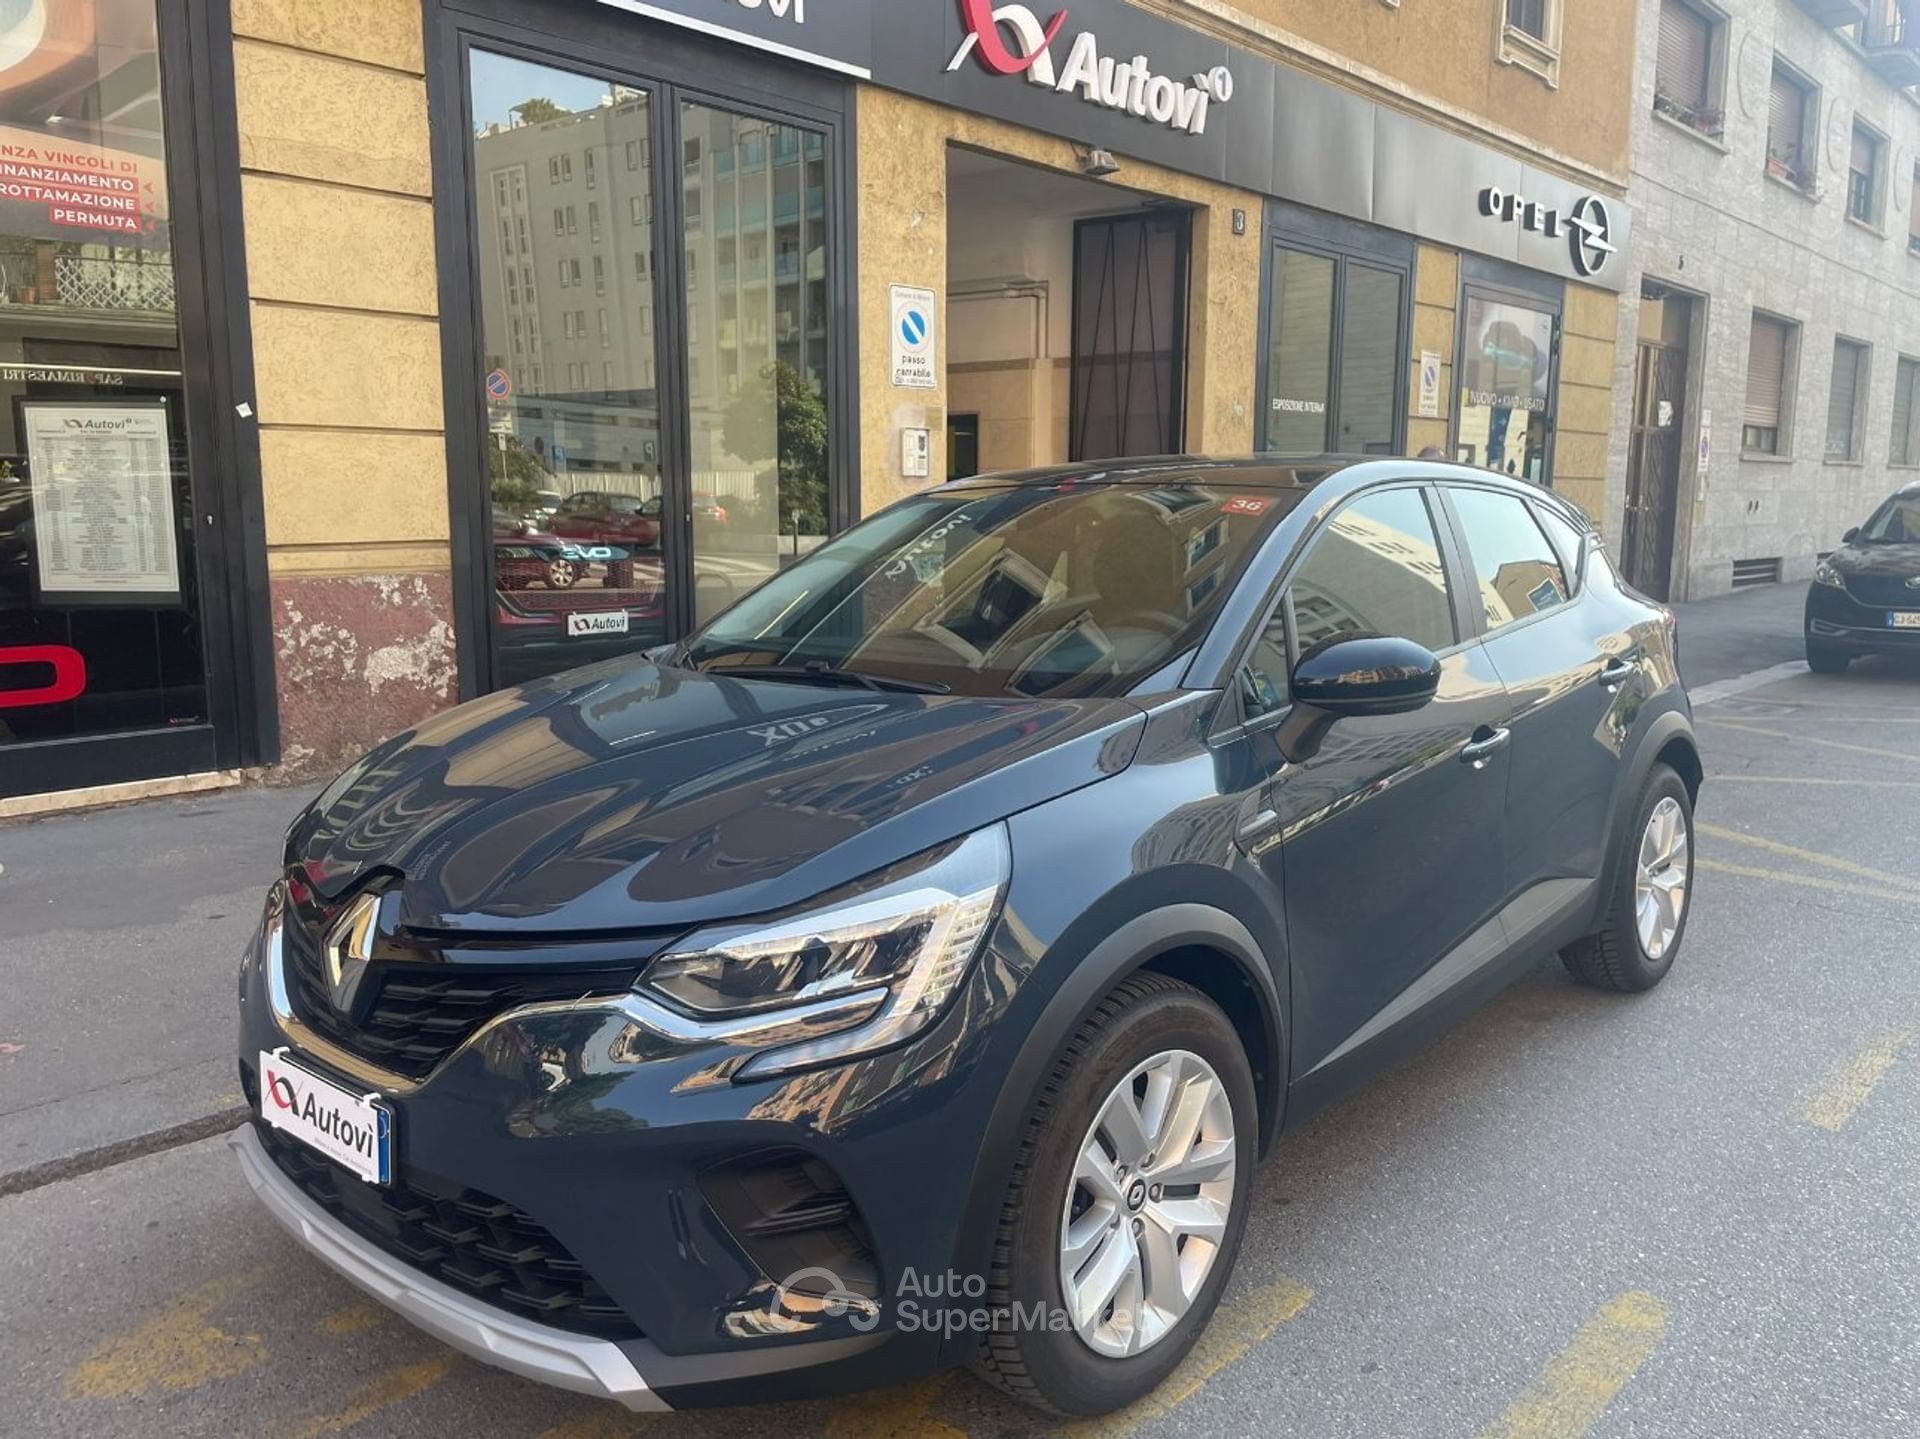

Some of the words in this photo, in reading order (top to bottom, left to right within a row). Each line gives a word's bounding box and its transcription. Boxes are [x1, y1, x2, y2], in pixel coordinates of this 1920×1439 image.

[1055, 31, 1209, 135] Autovì
[44, 150, 114, 170] VINCOLI
[121, 161, 138, 173] DI
[53, 208, 137, 229] PERMUTA
[1479, 186, 1564, 238] OPEL
[1231, 499, 1262, 511] 36
[302, 1092, 374, 1159] Autovì
